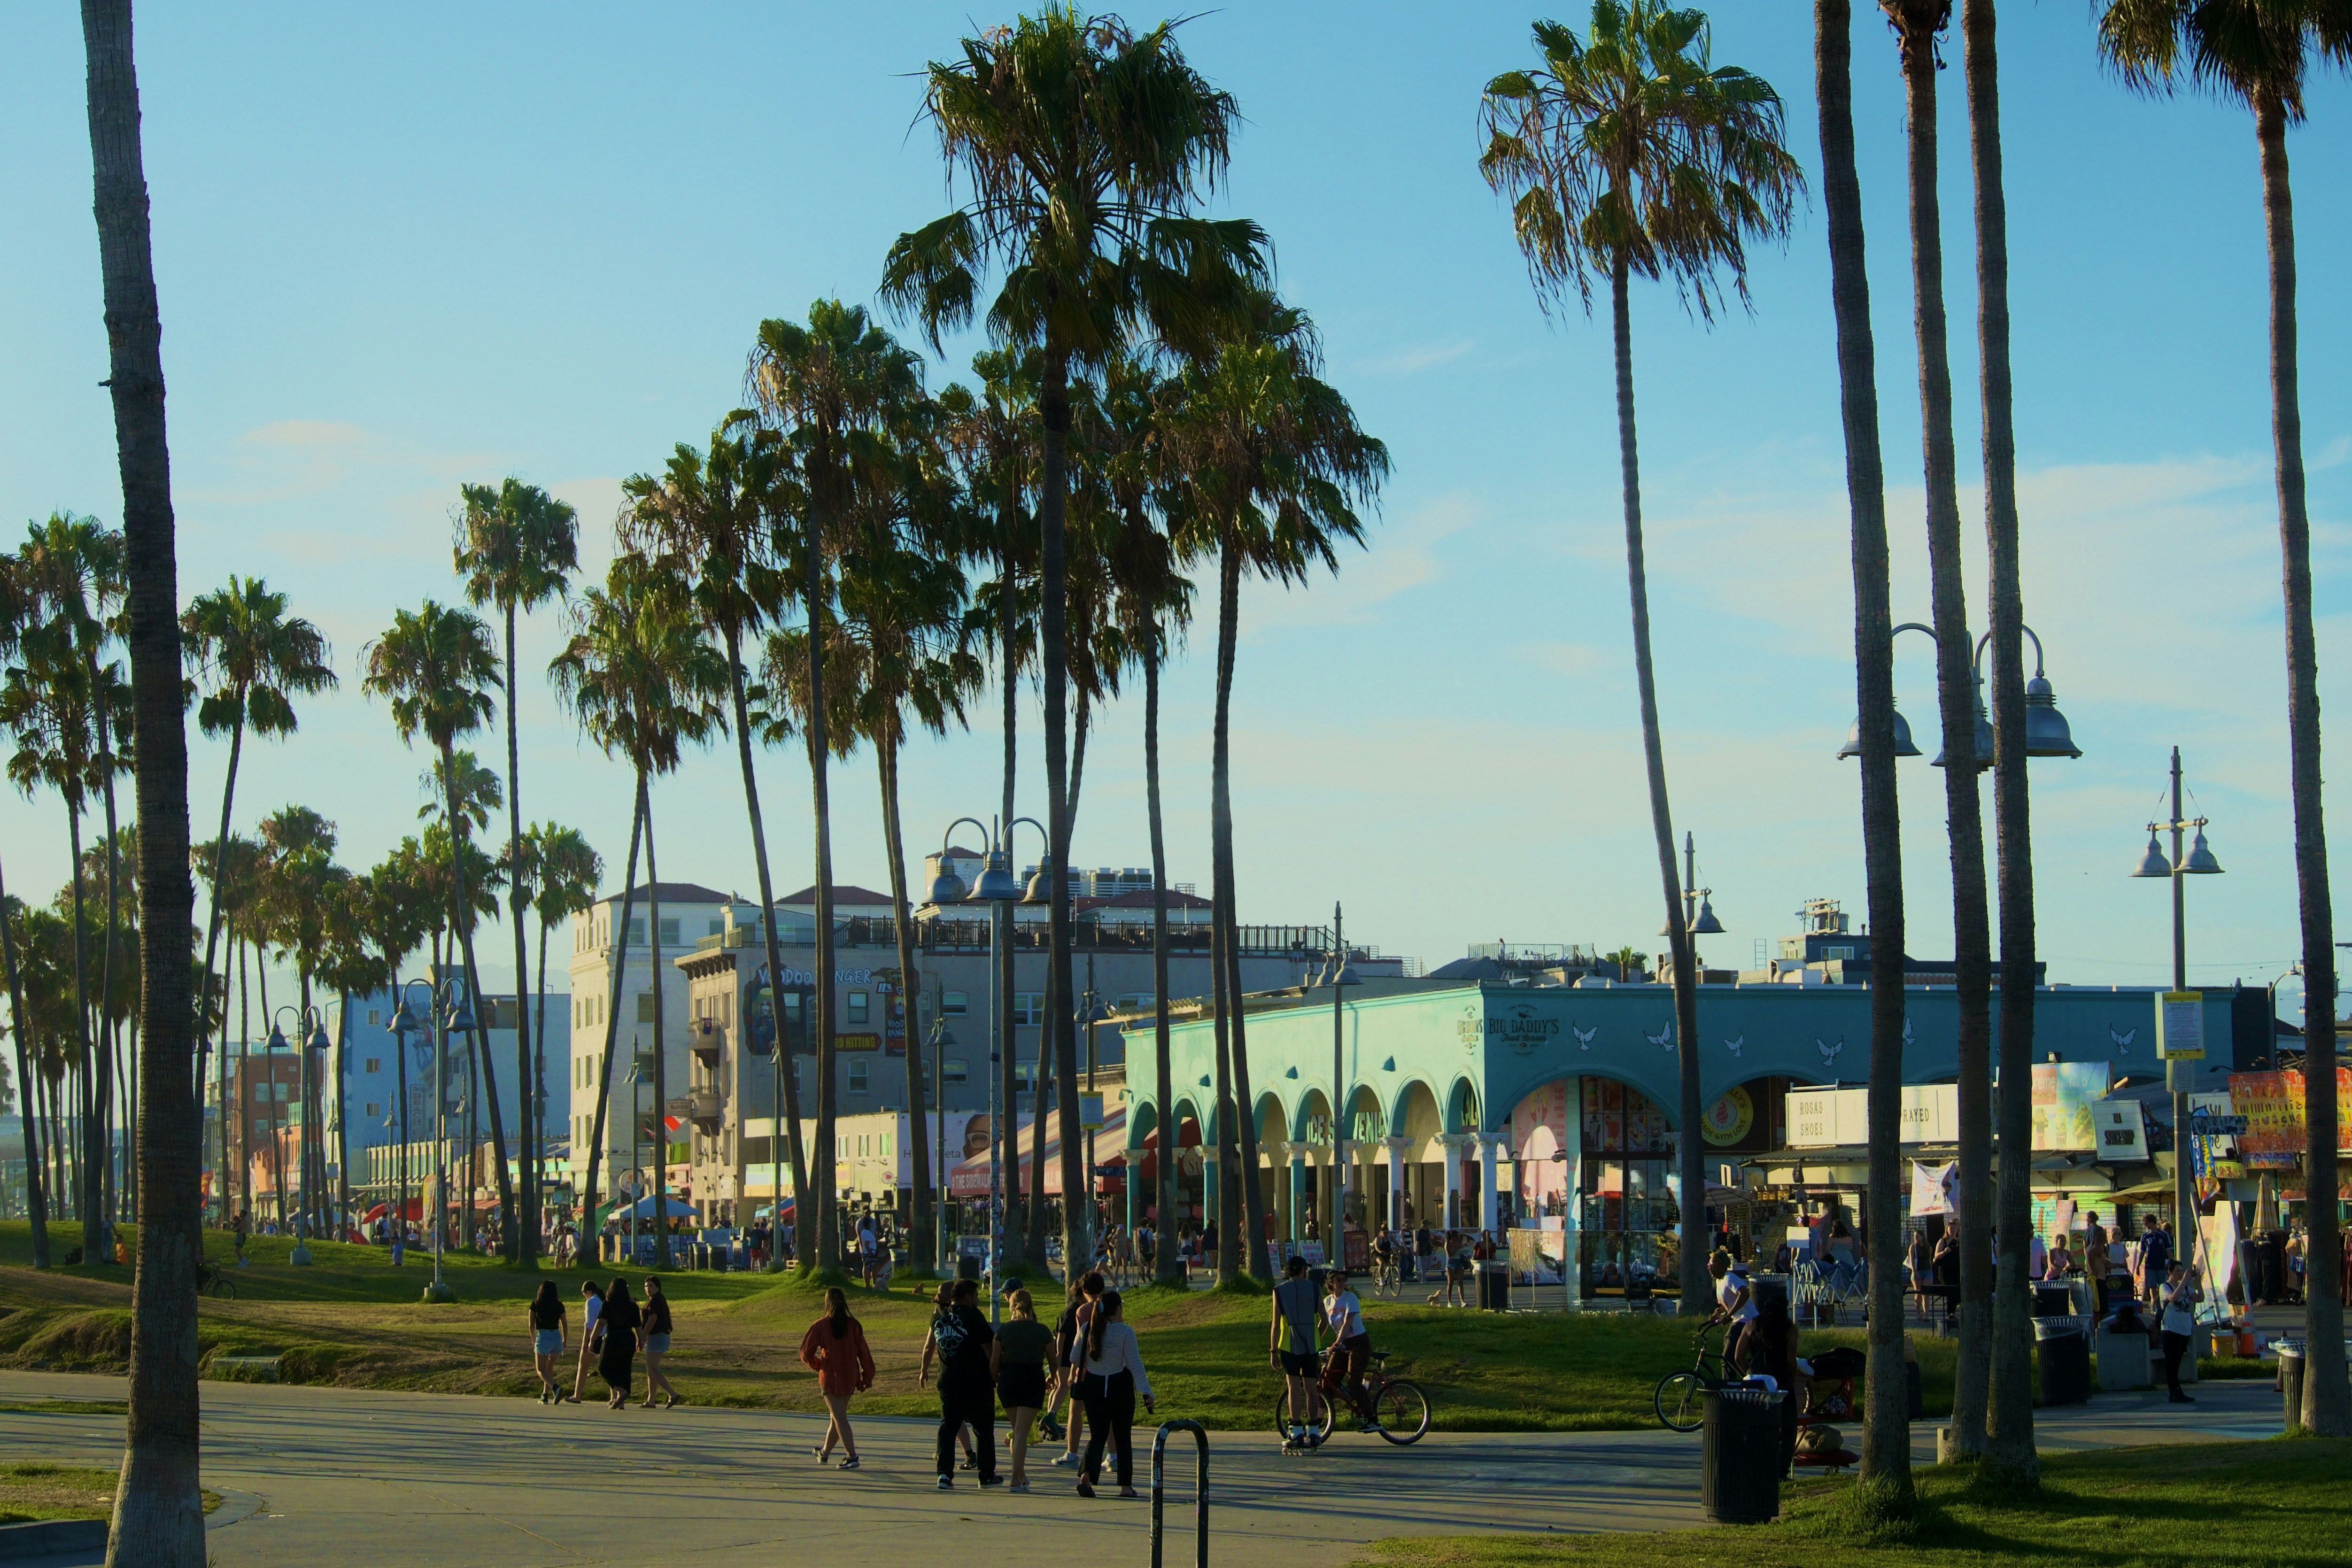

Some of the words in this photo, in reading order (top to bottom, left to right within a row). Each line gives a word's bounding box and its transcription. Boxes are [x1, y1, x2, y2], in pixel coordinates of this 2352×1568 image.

[835, 968, 872, 984] NGER
[1489, 1018, 1506, 1034] BIG
[1511, 1019, 1559, 1034] DADDY'S
[835, 1037, 843, 1048] RD
[846, 1036, 874, 1048] HITTING
[1800, 1101, 1823, 1115] ROSA'S
[1903, 1108, 1929, 1122] RAYED
[1307, 1115, 1324, 1146] ICE
[1733, 1118, 1746, 1136] LOVE
[1800, 1123, 1823, 1136] SHOES
[2104, 1129, 2135, 1145] SPACESHIP
[936, 1150, 960, 1158] eta
[955, 1175, 965, 1189] THE
